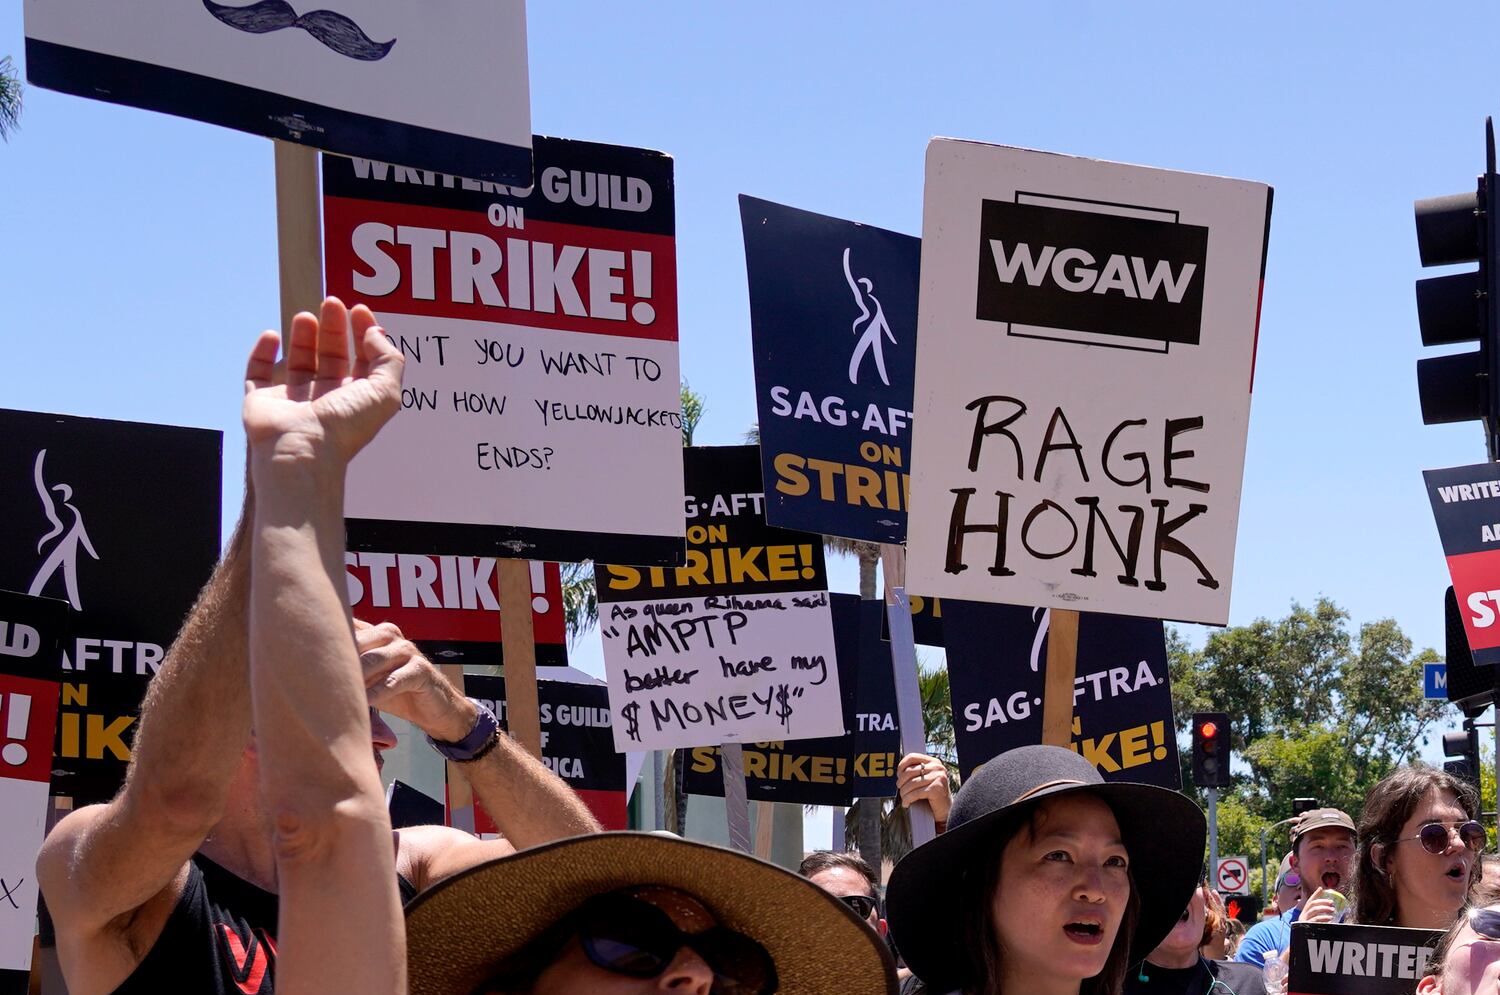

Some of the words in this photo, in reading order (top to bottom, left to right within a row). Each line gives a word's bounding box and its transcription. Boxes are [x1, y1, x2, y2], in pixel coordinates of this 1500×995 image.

[540, 167, 653, 213] GUILD
[487, 203, 525, 230] ON
[351, 222, 656, 326] STRIKE!
[988, 239, 1197, 304] WGAW
[474, 339, 524, 368] YOU
[540, 349, 616, 376] WANT
[625, 356, 662, 382] TO
[453, 391, 507, 415] HOW
[534, 399, 682, 430] YELLOWJACKETS
[477, 443, 554, 470] ENDS?
[859, 441, 902, 468] ON
[965, 395, 1211, 495] RAGE
[687, 524, 728, 544] ON
[944, 487, 1221, 592] HONK
[610, 603, 638, 621] As
[792, 592, 828, 608] said
[623, 667, 699, 694] better
[719, 655, 777, 678] have
[791, 655, 827, 685] my
[556, 706, 613, 728] GUILD
